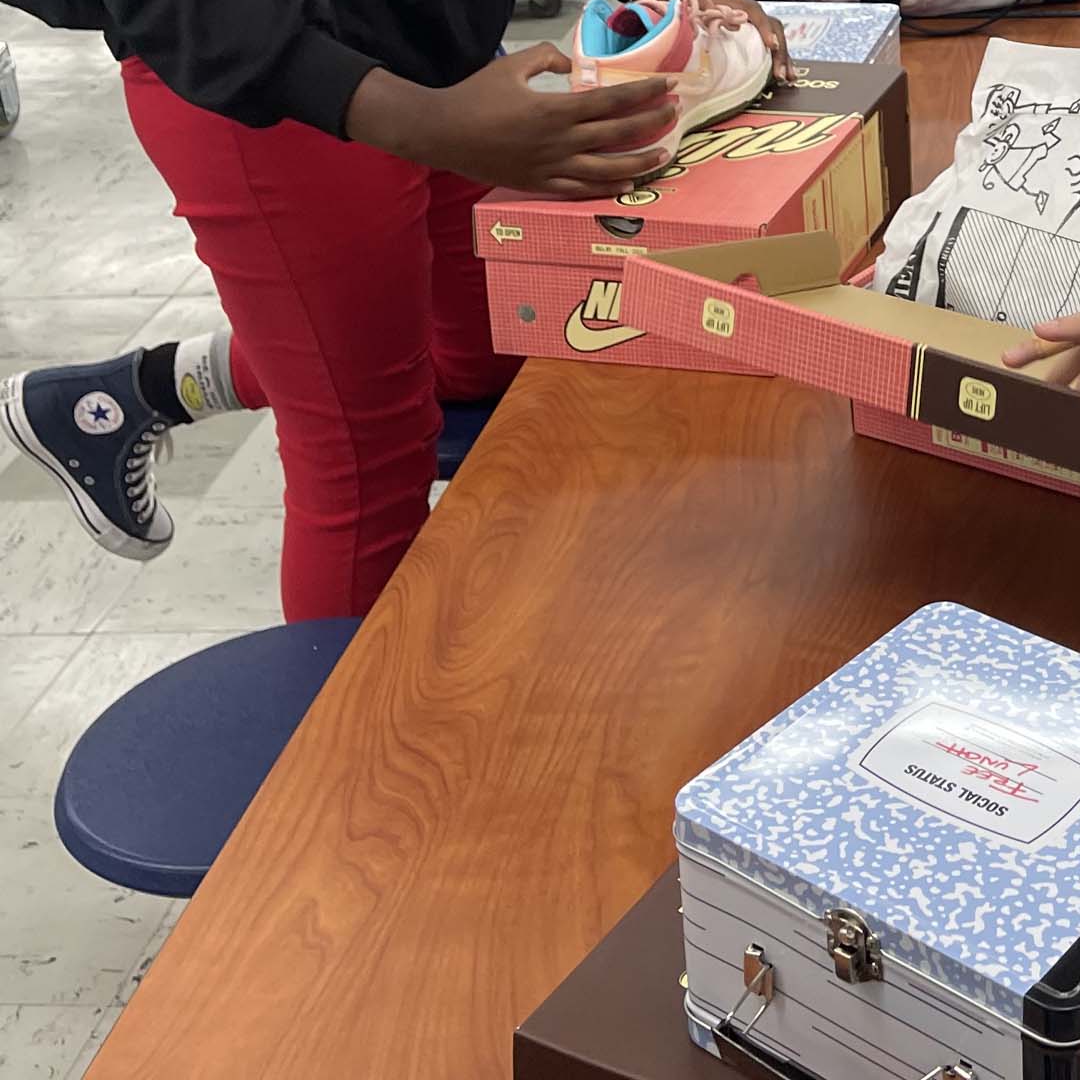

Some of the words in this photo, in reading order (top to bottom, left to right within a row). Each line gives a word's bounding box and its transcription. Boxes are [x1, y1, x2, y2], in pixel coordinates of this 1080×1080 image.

[963, 397, 973, 411] UP
[975, 401, 991, 417] LIFT
[903, 763, 957, 793] STATUS
[957, 786, 1009, 817] SOCIAL
